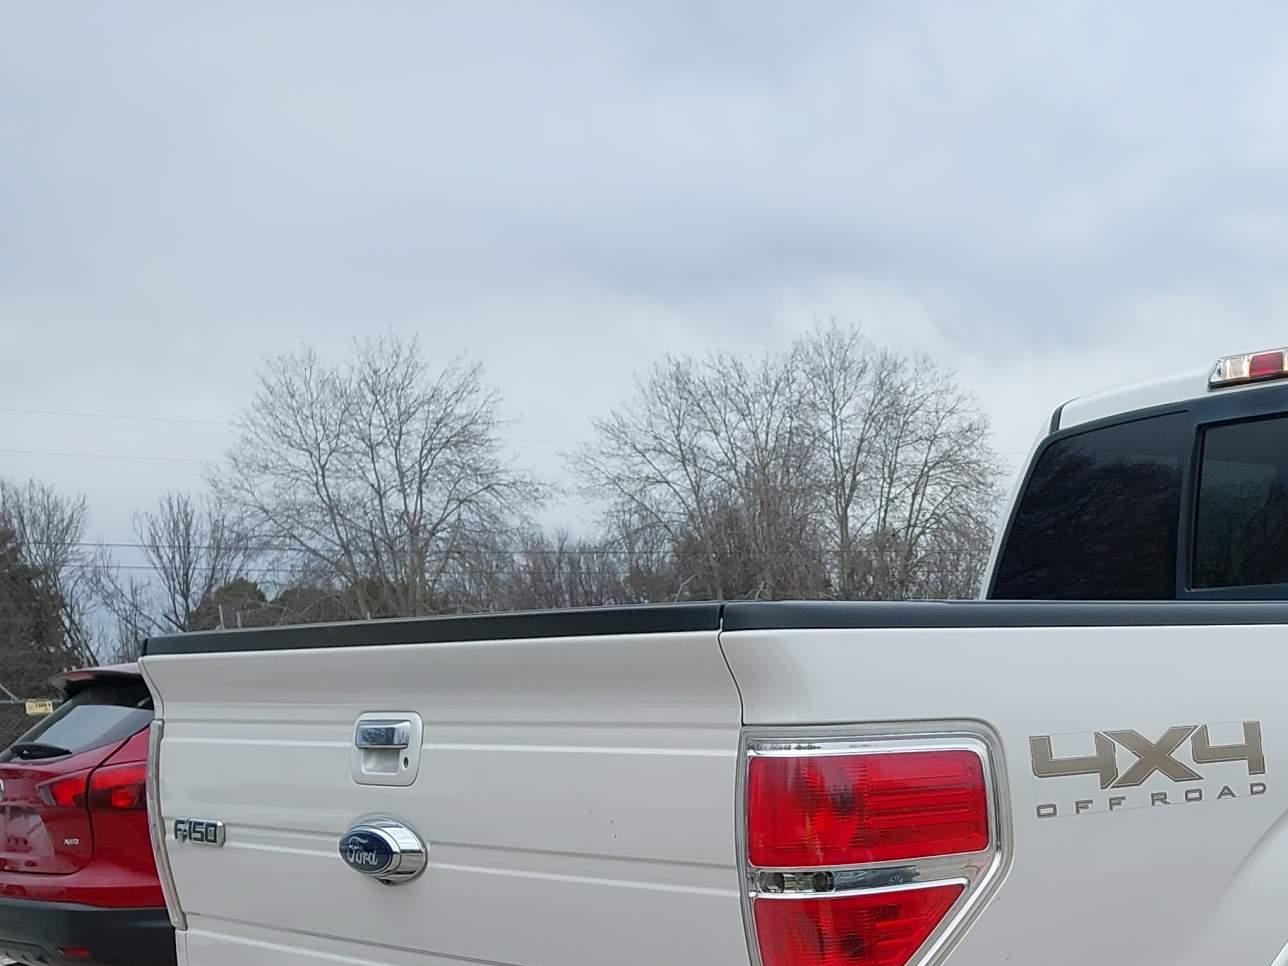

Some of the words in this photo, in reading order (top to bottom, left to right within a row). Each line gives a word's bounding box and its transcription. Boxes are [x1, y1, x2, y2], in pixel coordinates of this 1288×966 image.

[1029, 721, 1265, 789] 4X4
[1036, 796, 1126, 818] OFF
[1151, 783, 1267, 806] ROAD
[346, 836, 378, 866] Ford
